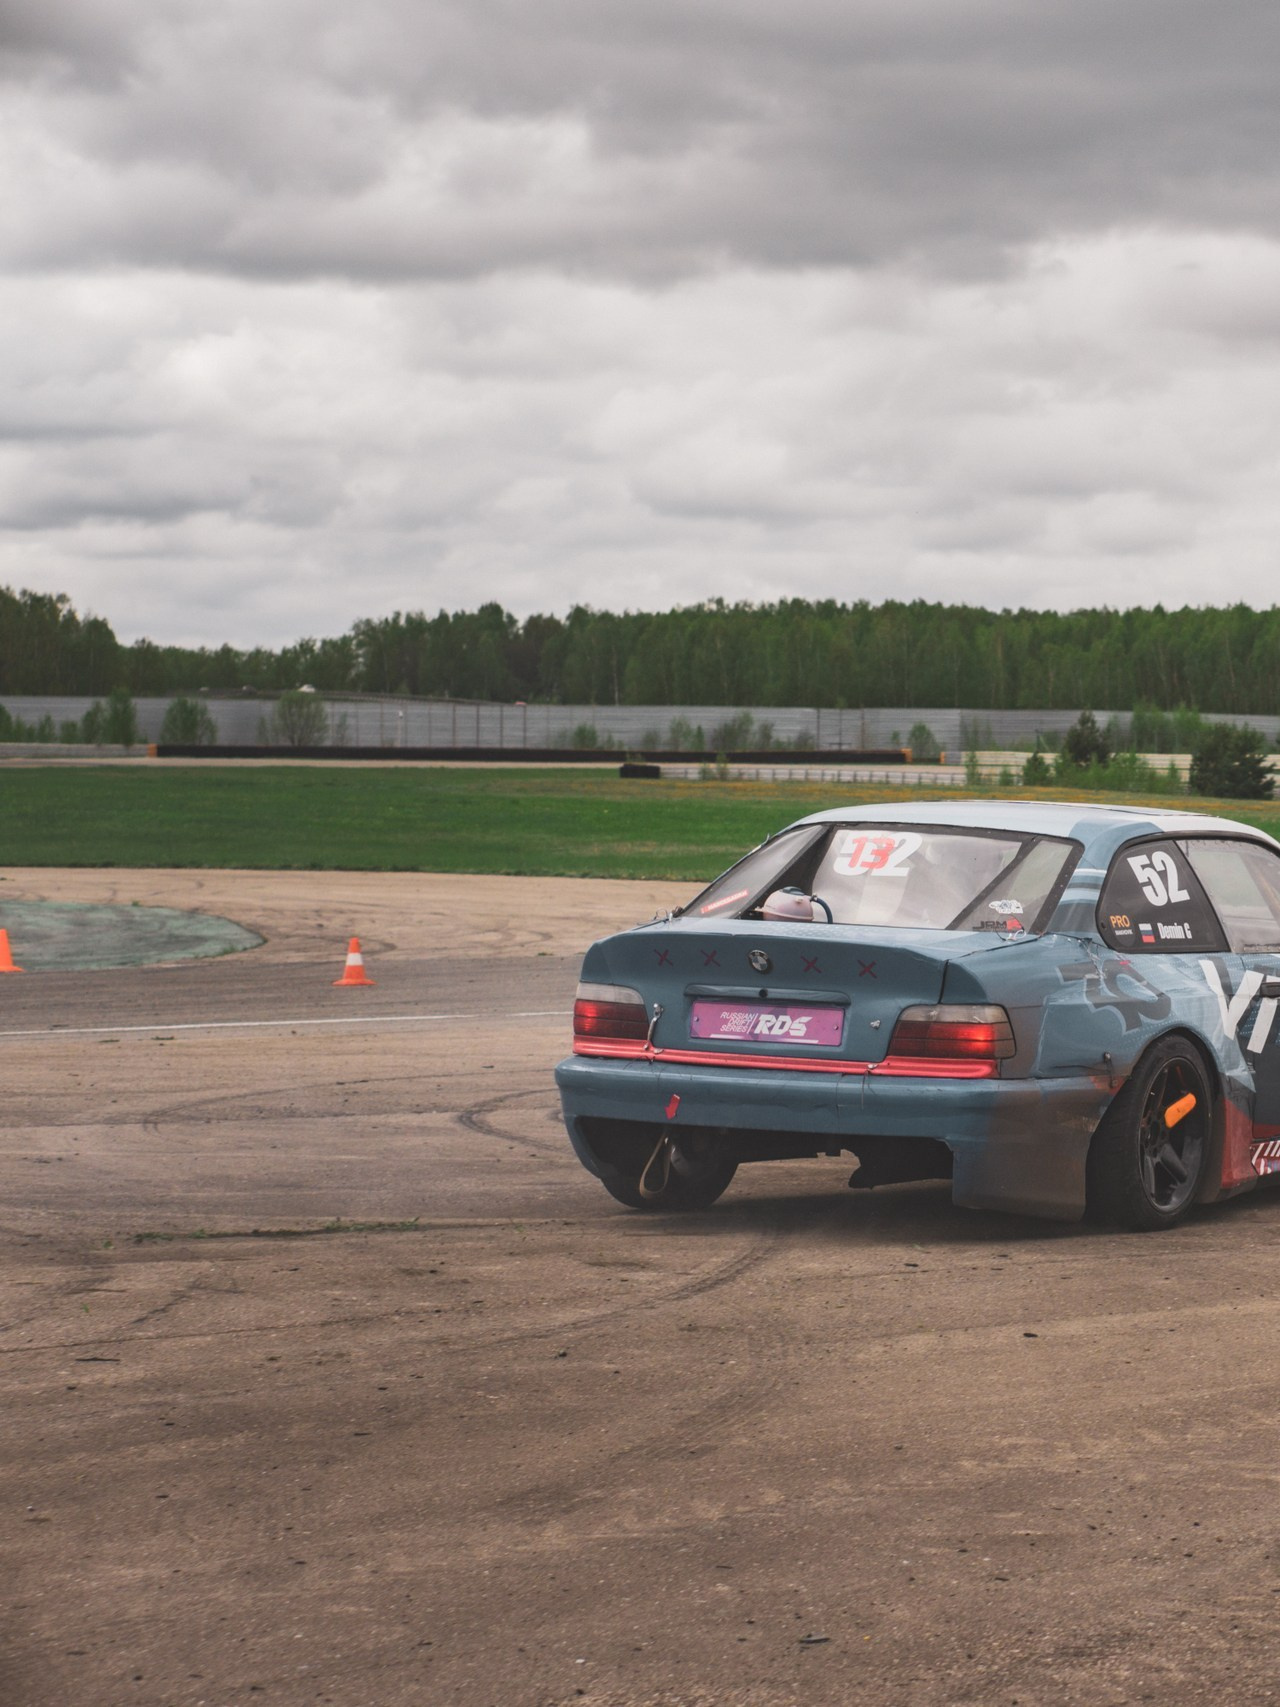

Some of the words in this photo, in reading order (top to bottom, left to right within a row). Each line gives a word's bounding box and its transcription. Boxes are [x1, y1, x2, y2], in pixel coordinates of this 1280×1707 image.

[1126, 851, 1190, 906] 52
[1109, 915, 1130, 928] PRO
[1157, 923, 1185, 939] Demin
[1183, 922, 1192, 939] G
[720, 1011, 755, 1020] RUSSIAN
[728, 1017, 752, 1026] DRIFT
[720, 1024, 748, 1032] SERIES
[754, 1014, 813, 1036] RDS
